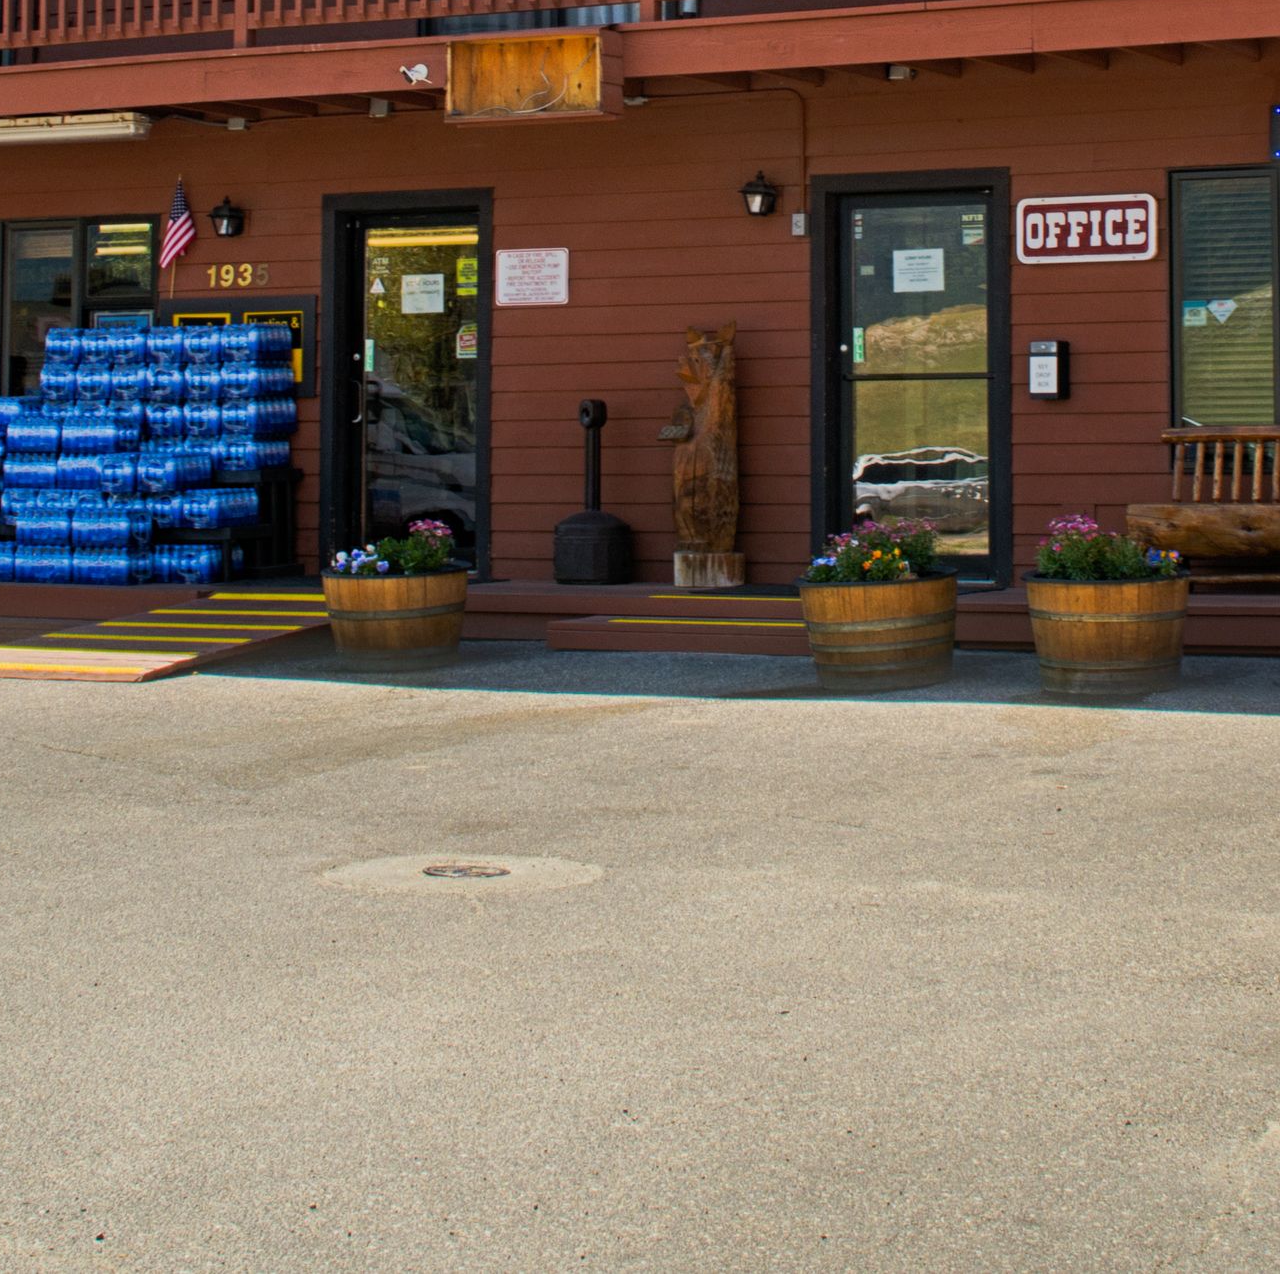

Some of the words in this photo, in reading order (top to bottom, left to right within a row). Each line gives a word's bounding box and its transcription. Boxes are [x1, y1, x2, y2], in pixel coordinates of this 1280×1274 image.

[1026, 208, 1147, 249] OFFICE
[207, 263, 269, 288] 1935
[291, 317, 300, 328] &
